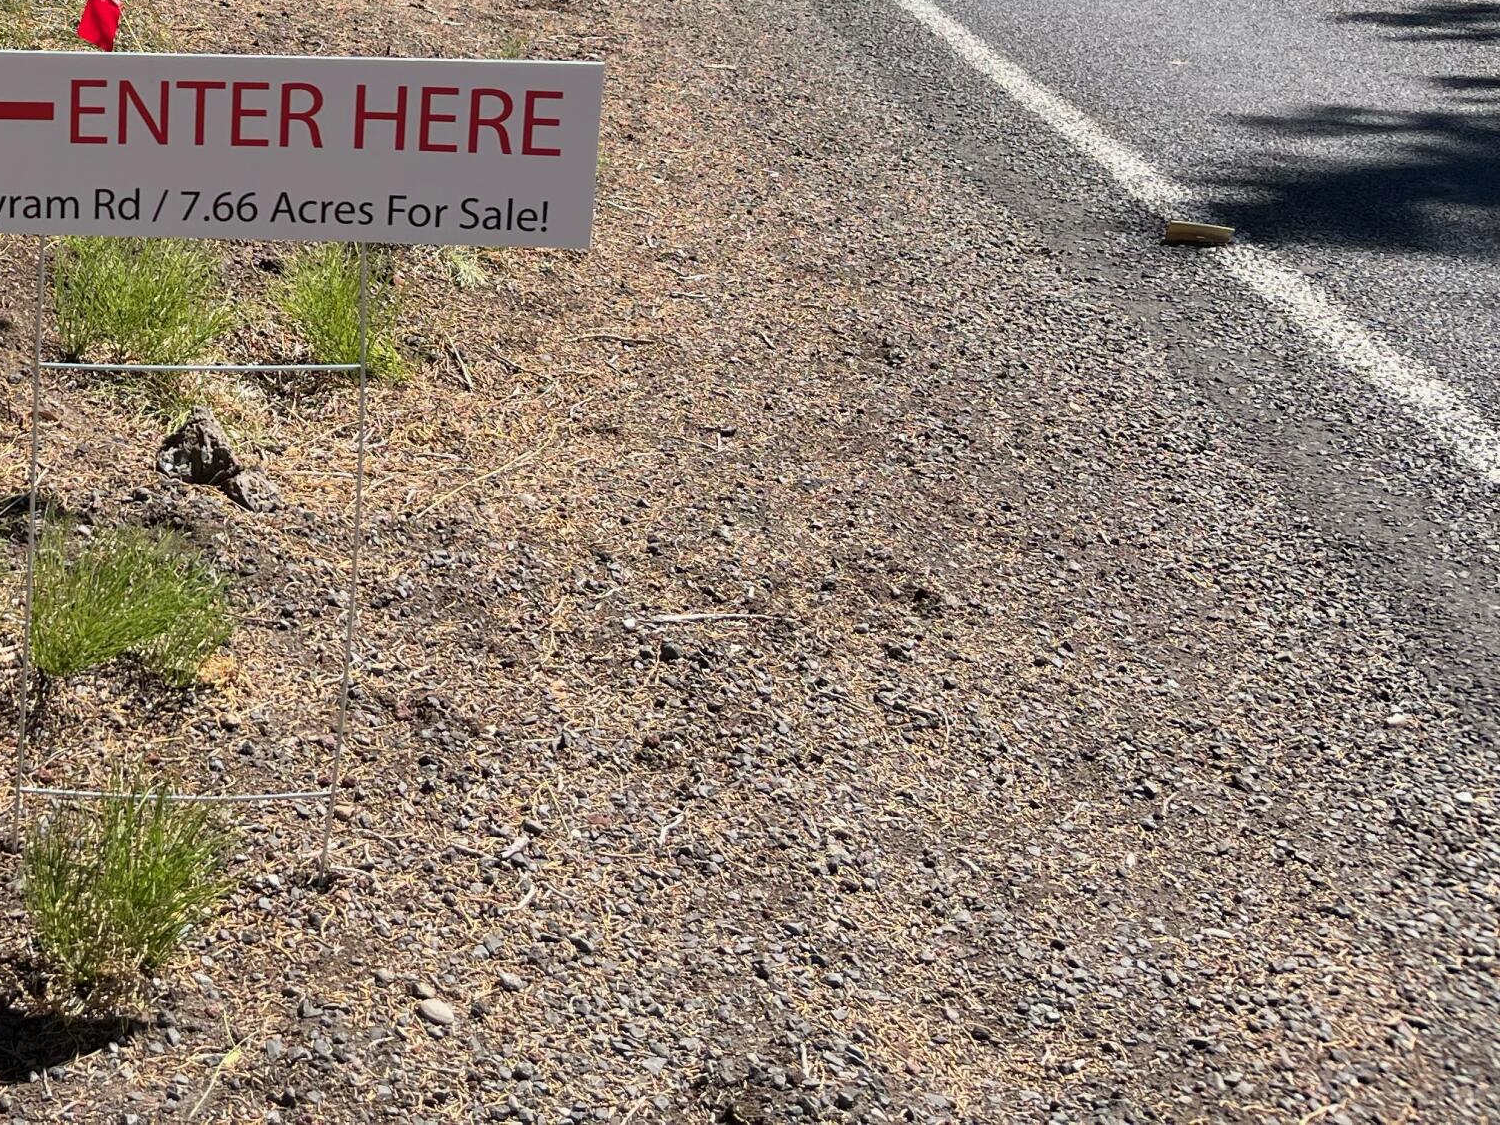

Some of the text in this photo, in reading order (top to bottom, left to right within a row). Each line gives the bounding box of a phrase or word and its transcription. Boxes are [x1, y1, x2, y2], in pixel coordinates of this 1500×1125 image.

[69, 78, 564, 157] ENTER HERE
[94, 185, 141, 221] Rd
[151, 189, 169, 223] /
[180, 190, 259, 223] 7.66
[269, 191, 374, 226] Acres
[387, 194, 449, 228] For
[458, 196, 550, 234] Sale!
